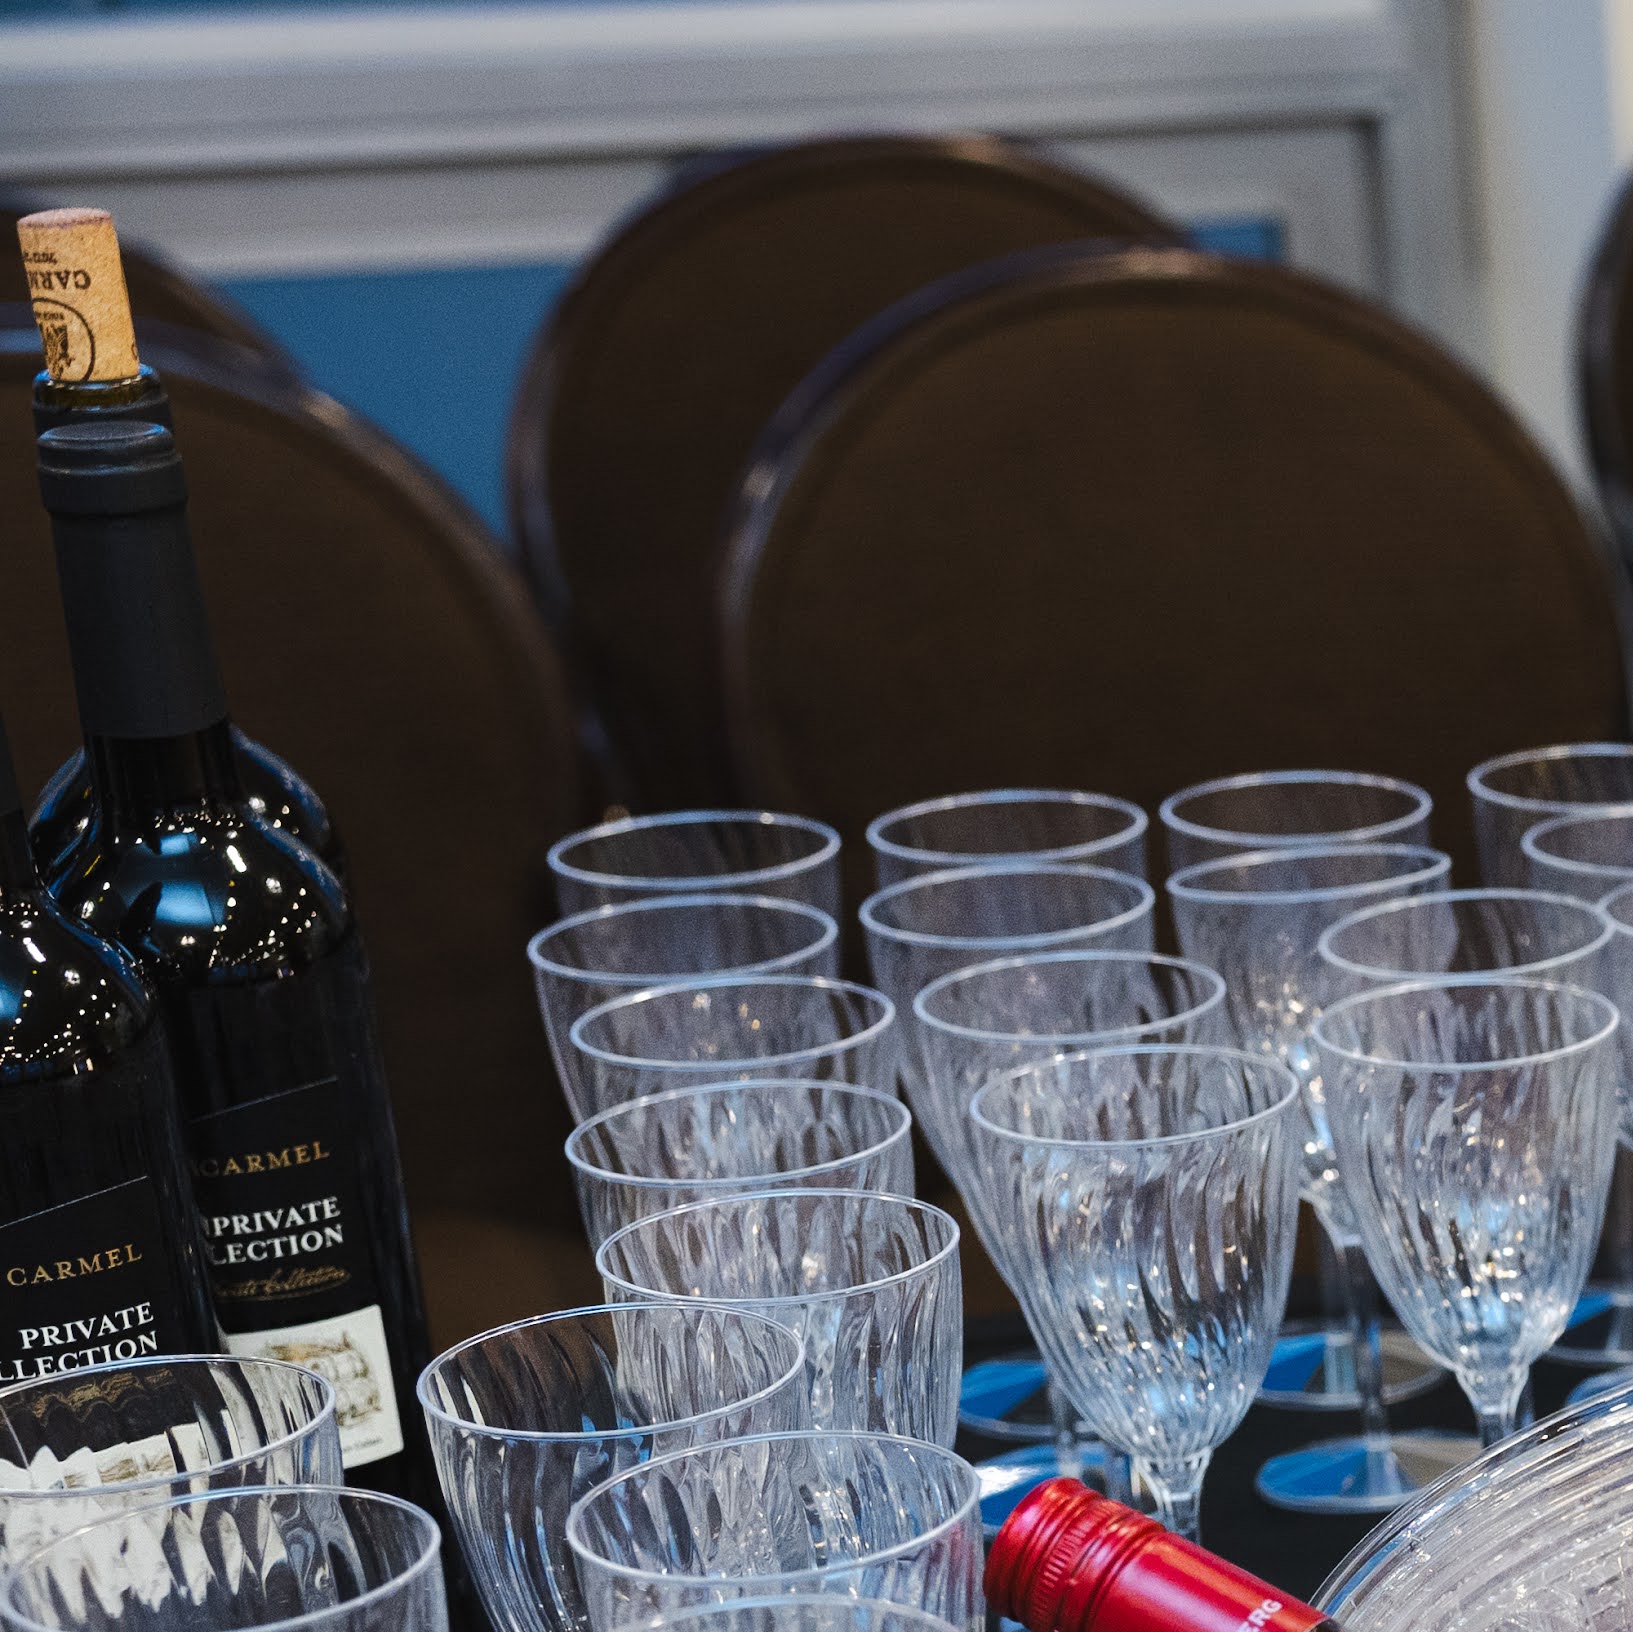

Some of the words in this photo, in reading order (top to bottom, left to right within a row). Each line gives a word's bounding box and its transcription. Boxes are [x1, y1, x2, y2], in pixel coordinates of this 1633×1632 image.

[212, 1196, 341, 1237] PRIVATE
[6, 1244, 142, 1286] CARMEL
[18, 1302, 154, 1350] PRIVATE
